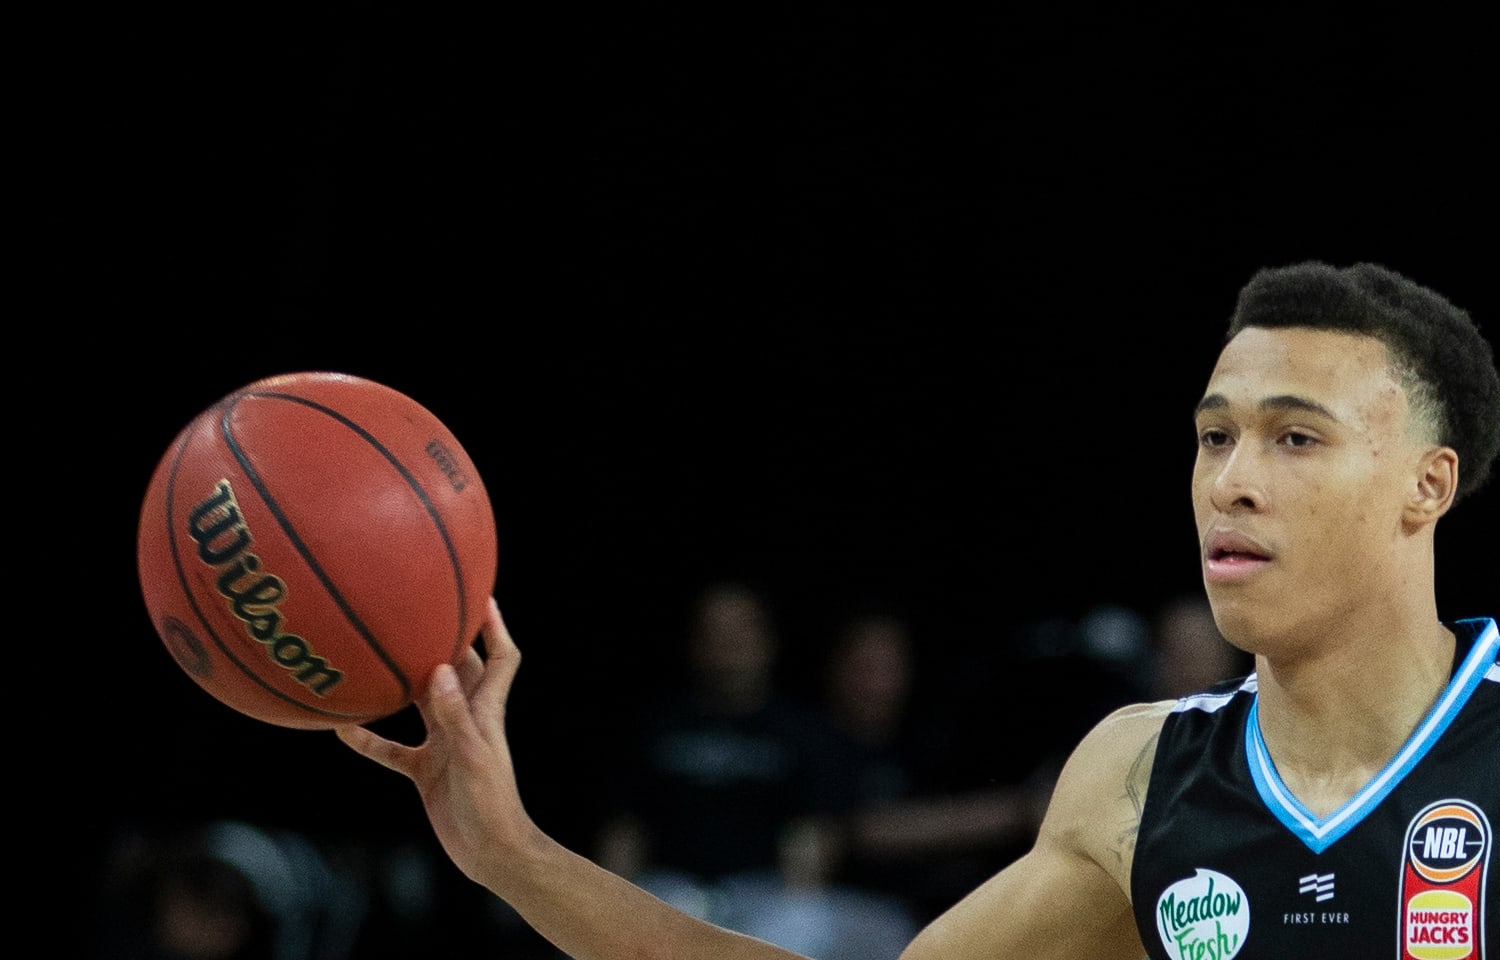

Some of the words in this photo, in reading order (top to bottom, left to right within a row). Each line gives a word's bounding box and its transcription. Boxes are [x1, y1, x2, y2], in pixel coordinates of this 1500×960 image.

[187, 478, 345, 699] Wilson
[1423, 826, 1467, 859] NBL
[1159, 877, 1241, 943] Meadow
[1283, 912, 1315, 924] FIRST
[1321, 912, 1349, 924] EVER
[1410, 911, 1469, 924] HUNGRY
